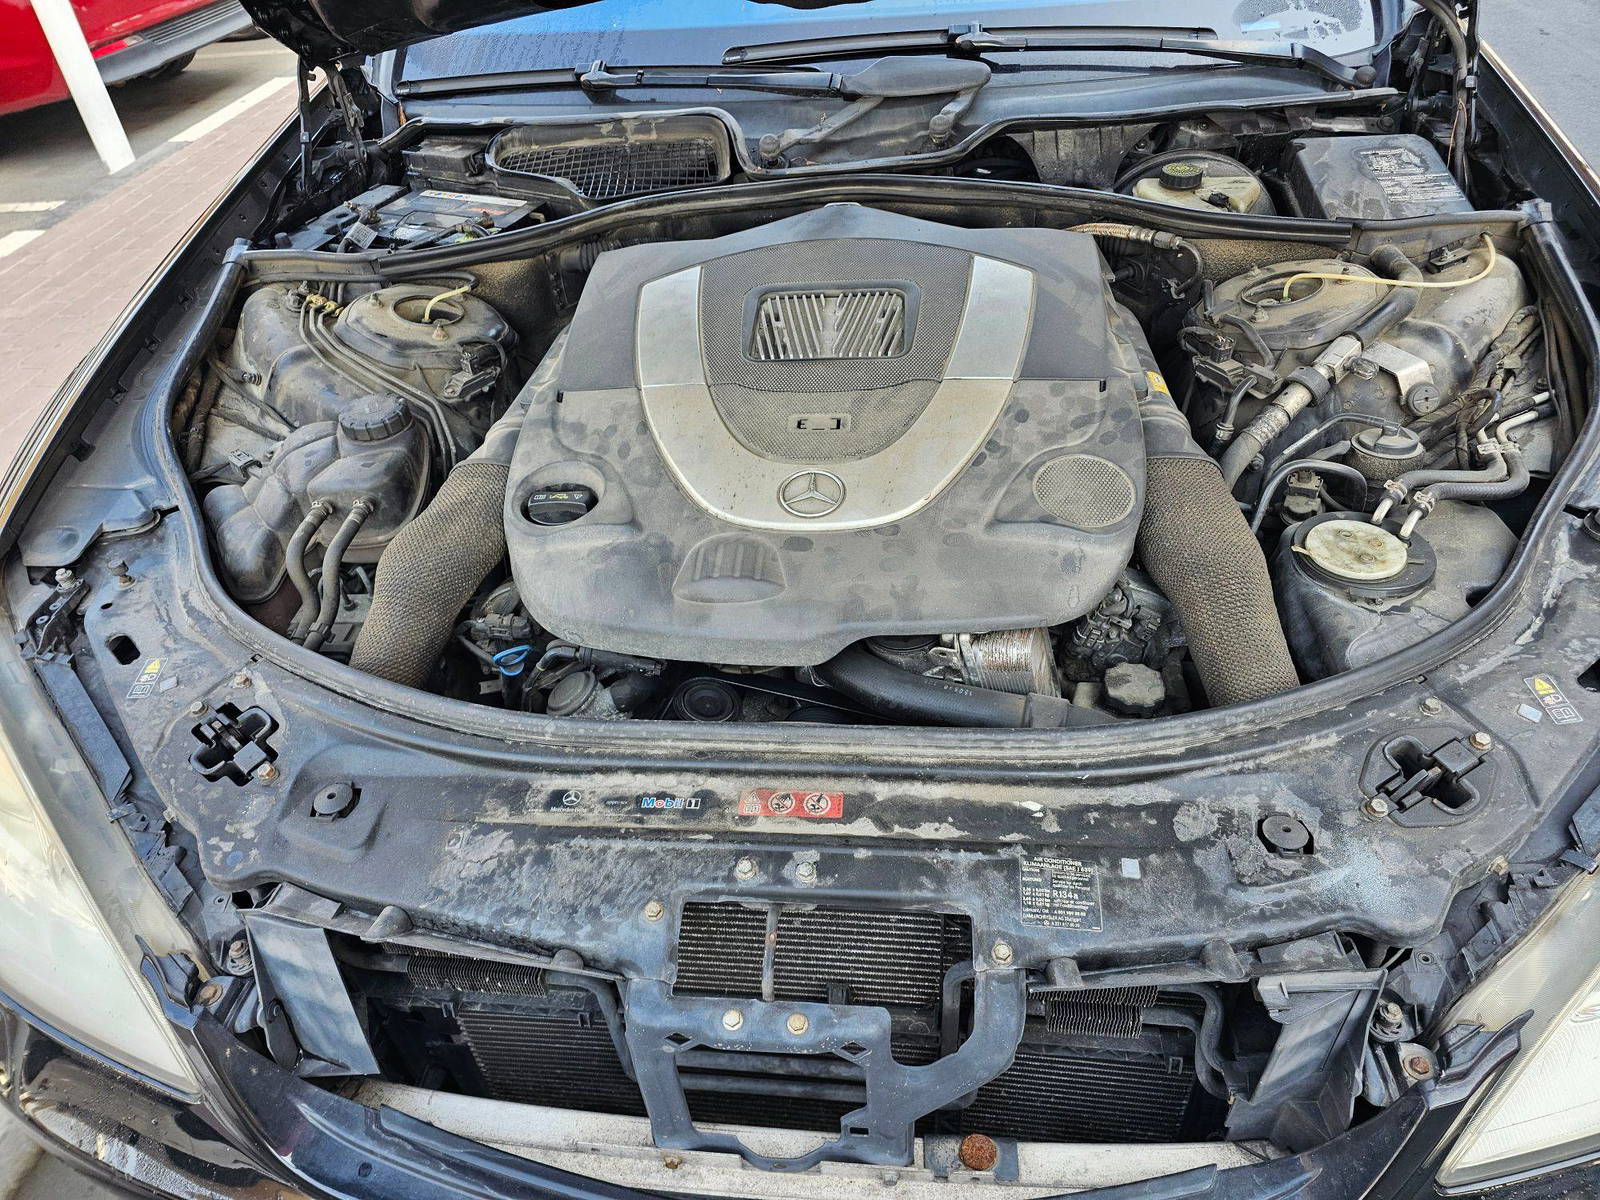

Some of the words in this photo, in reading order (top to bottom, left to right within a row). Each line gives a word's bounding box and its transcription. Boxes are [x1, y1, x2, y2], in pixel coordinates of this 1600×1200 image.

[641, 797, 684, 809] Mobil
[686, 798, 701, 809] 1
[1044, 857, 1082, 867] CONDITIONER
[1052, 890, 1079, 900] R134a
